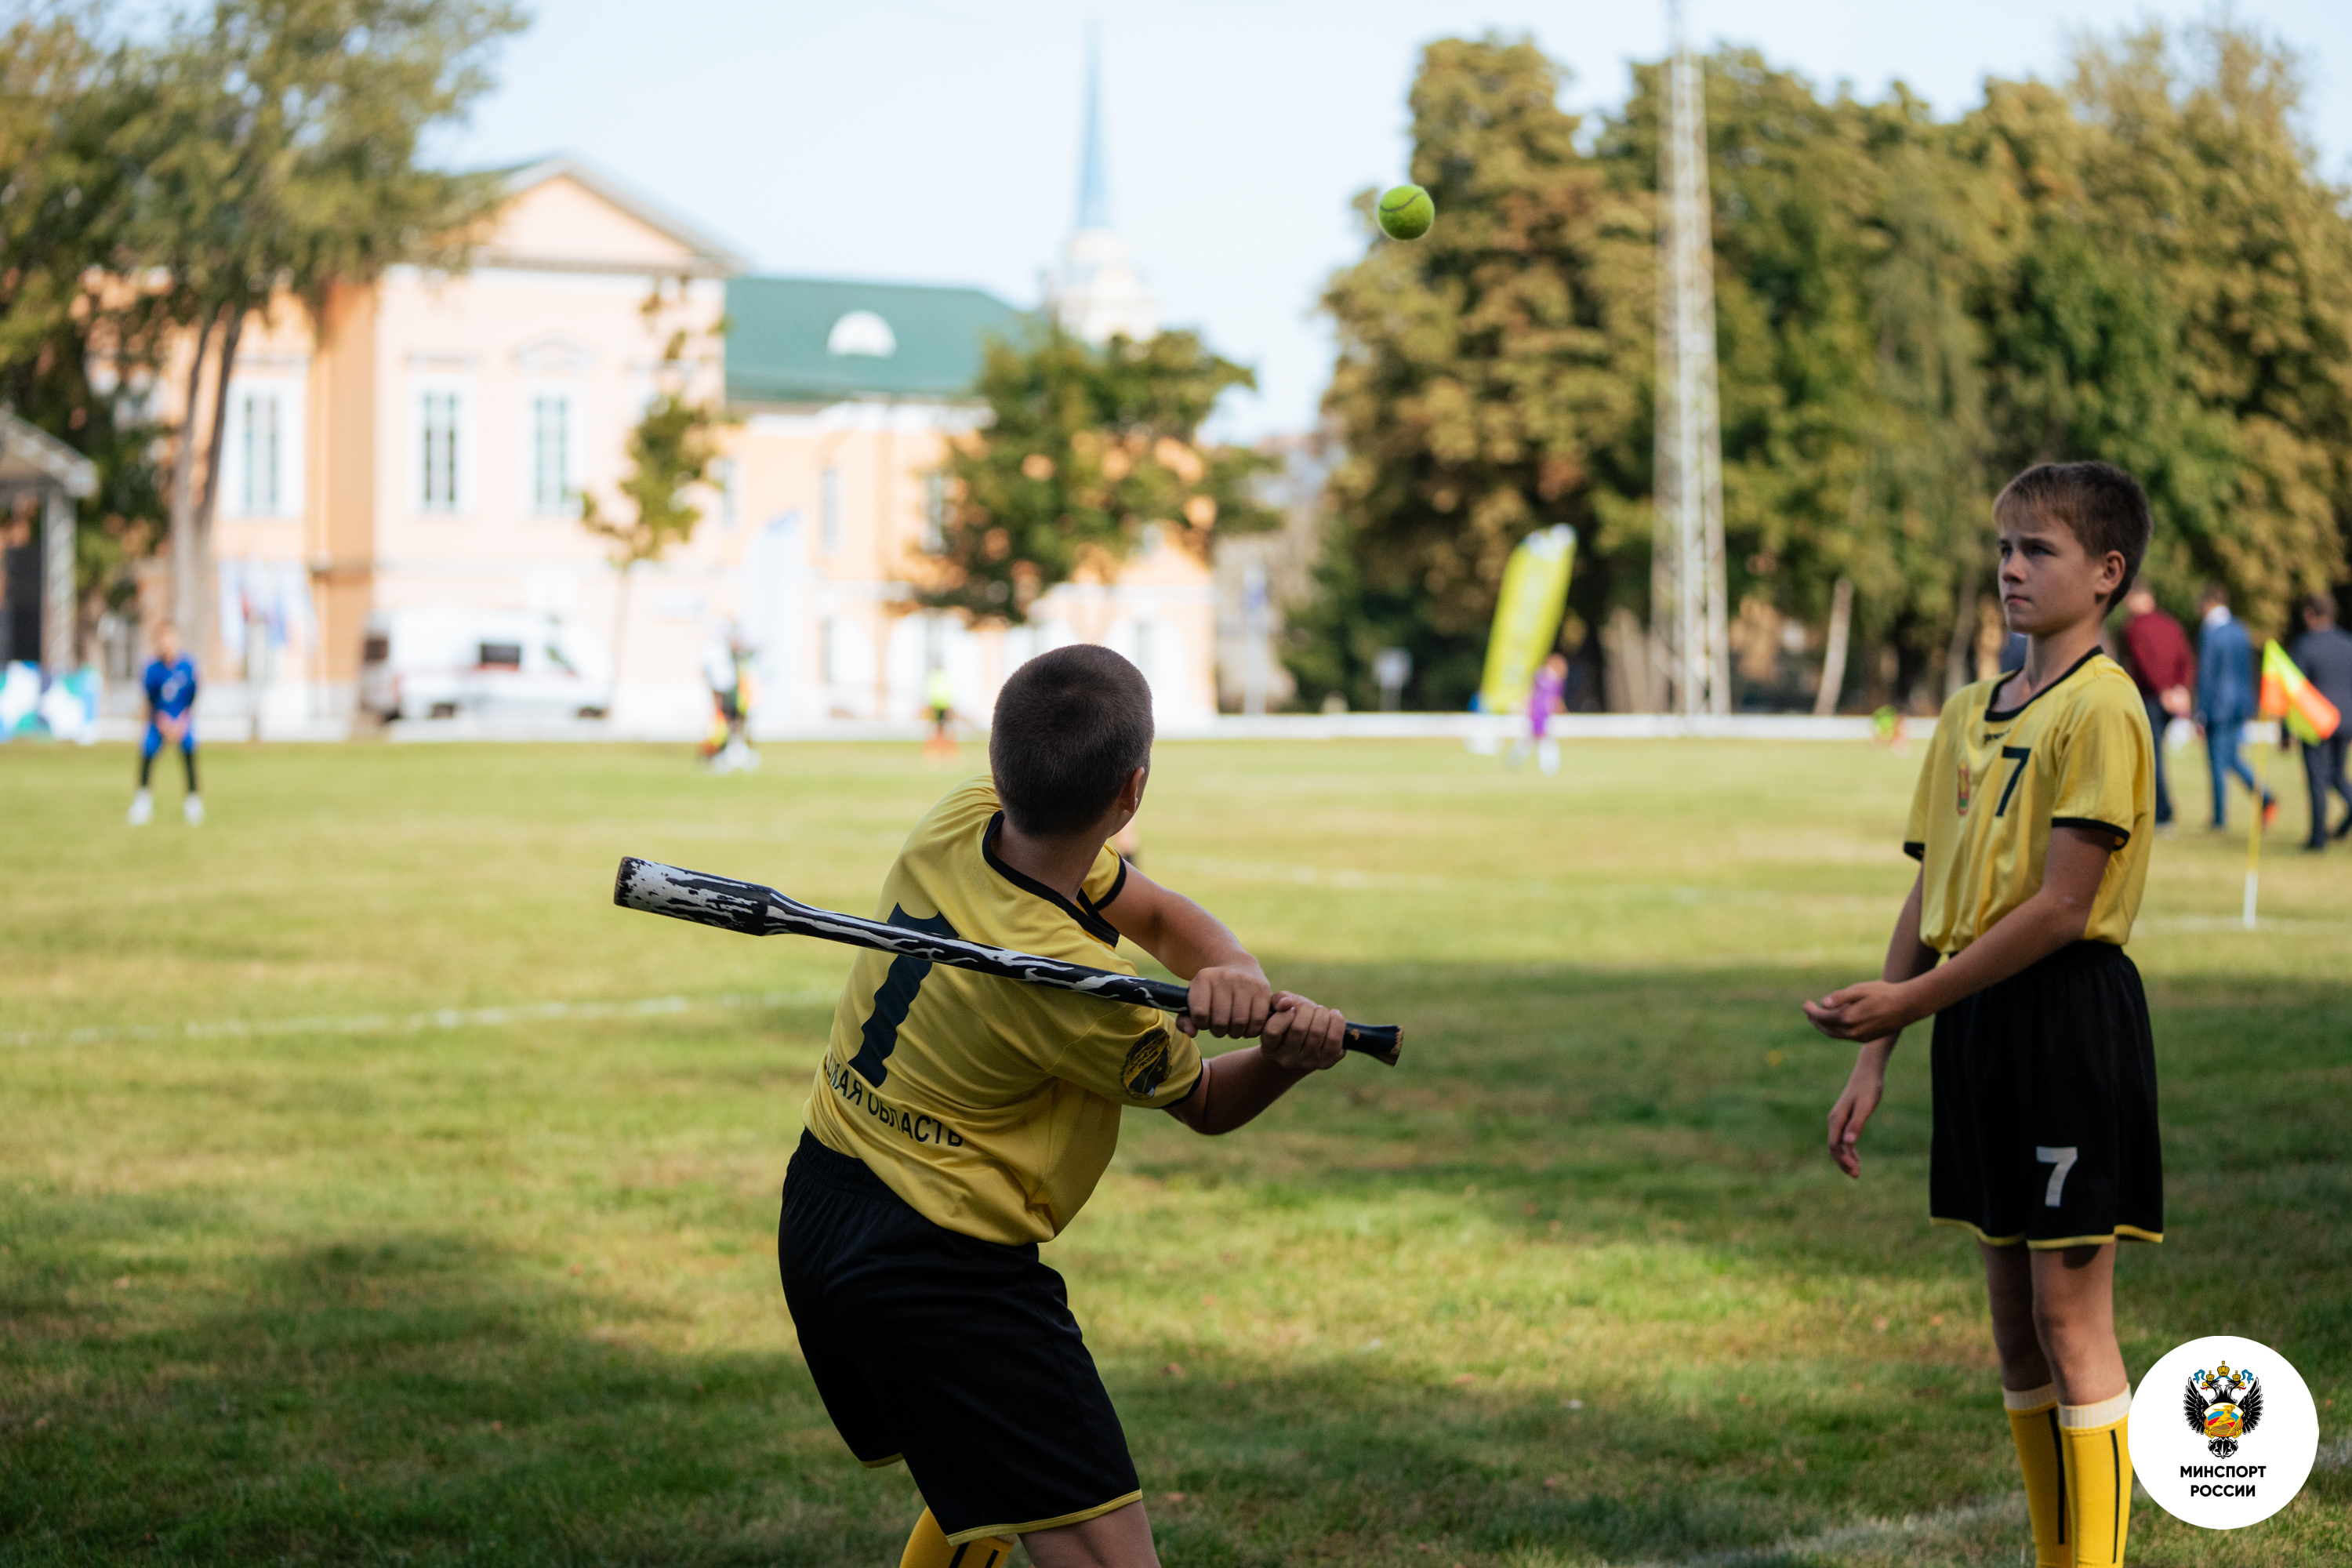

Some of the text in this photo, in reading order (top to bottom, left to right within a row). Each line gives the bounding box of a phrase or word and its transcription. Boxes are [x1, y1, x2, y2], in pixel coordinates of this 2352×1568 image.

[1996, 746, 2031, 817] 7
[868, 1092, 964, 1146] ОБЛАСТЬ
[2036, 1146, 2078, 1207] 7
